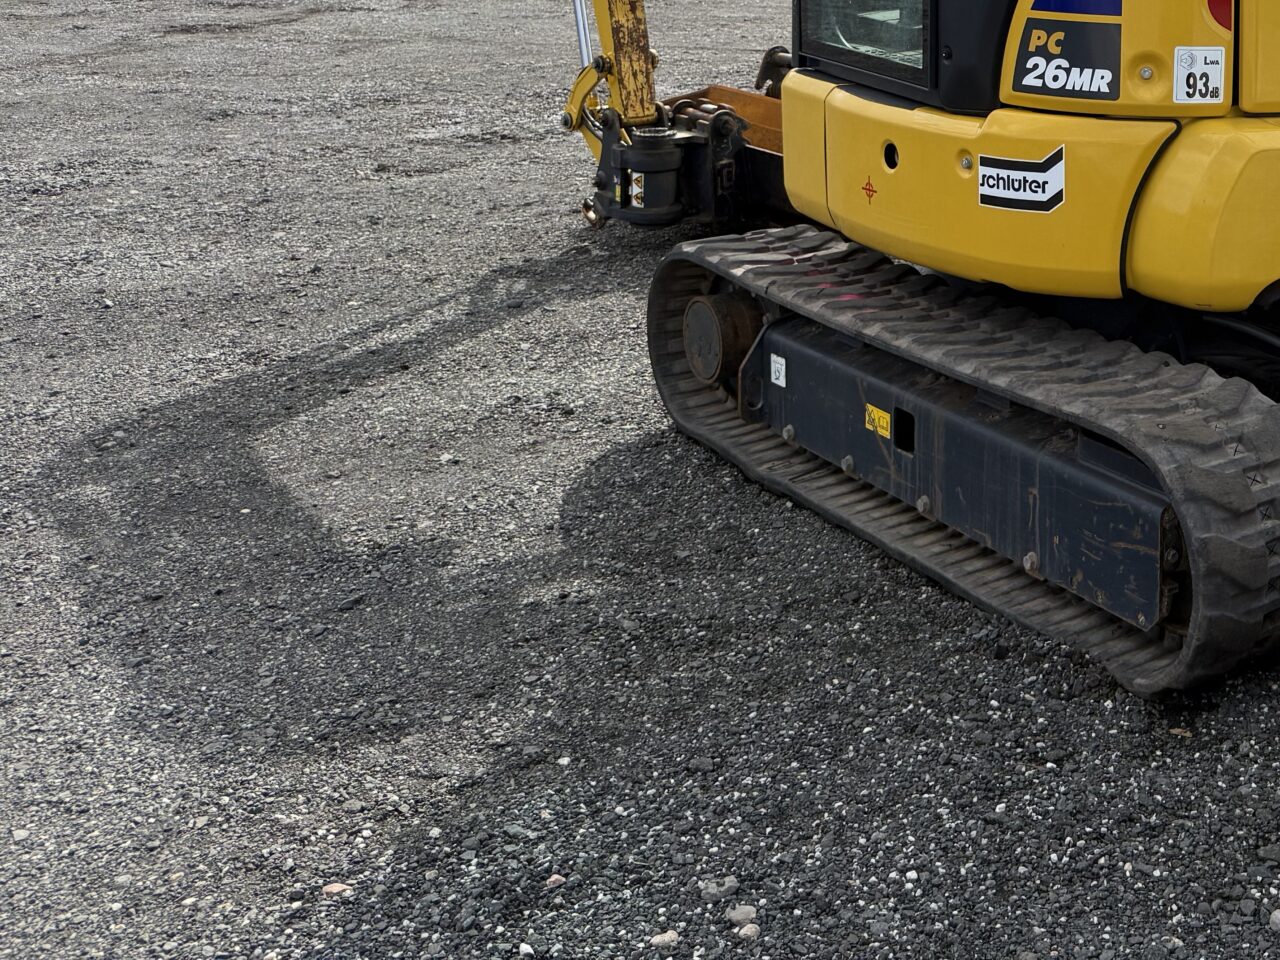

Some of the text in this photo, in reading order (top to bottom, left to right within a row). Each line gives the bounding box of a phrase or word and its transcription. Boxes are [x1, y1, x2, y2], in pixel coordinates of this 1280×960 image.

[1027, 29, 1065, 55] PC
[1021, 56, 1113, 93] 26MR
[979, 173, 1048, 194] schlüter
